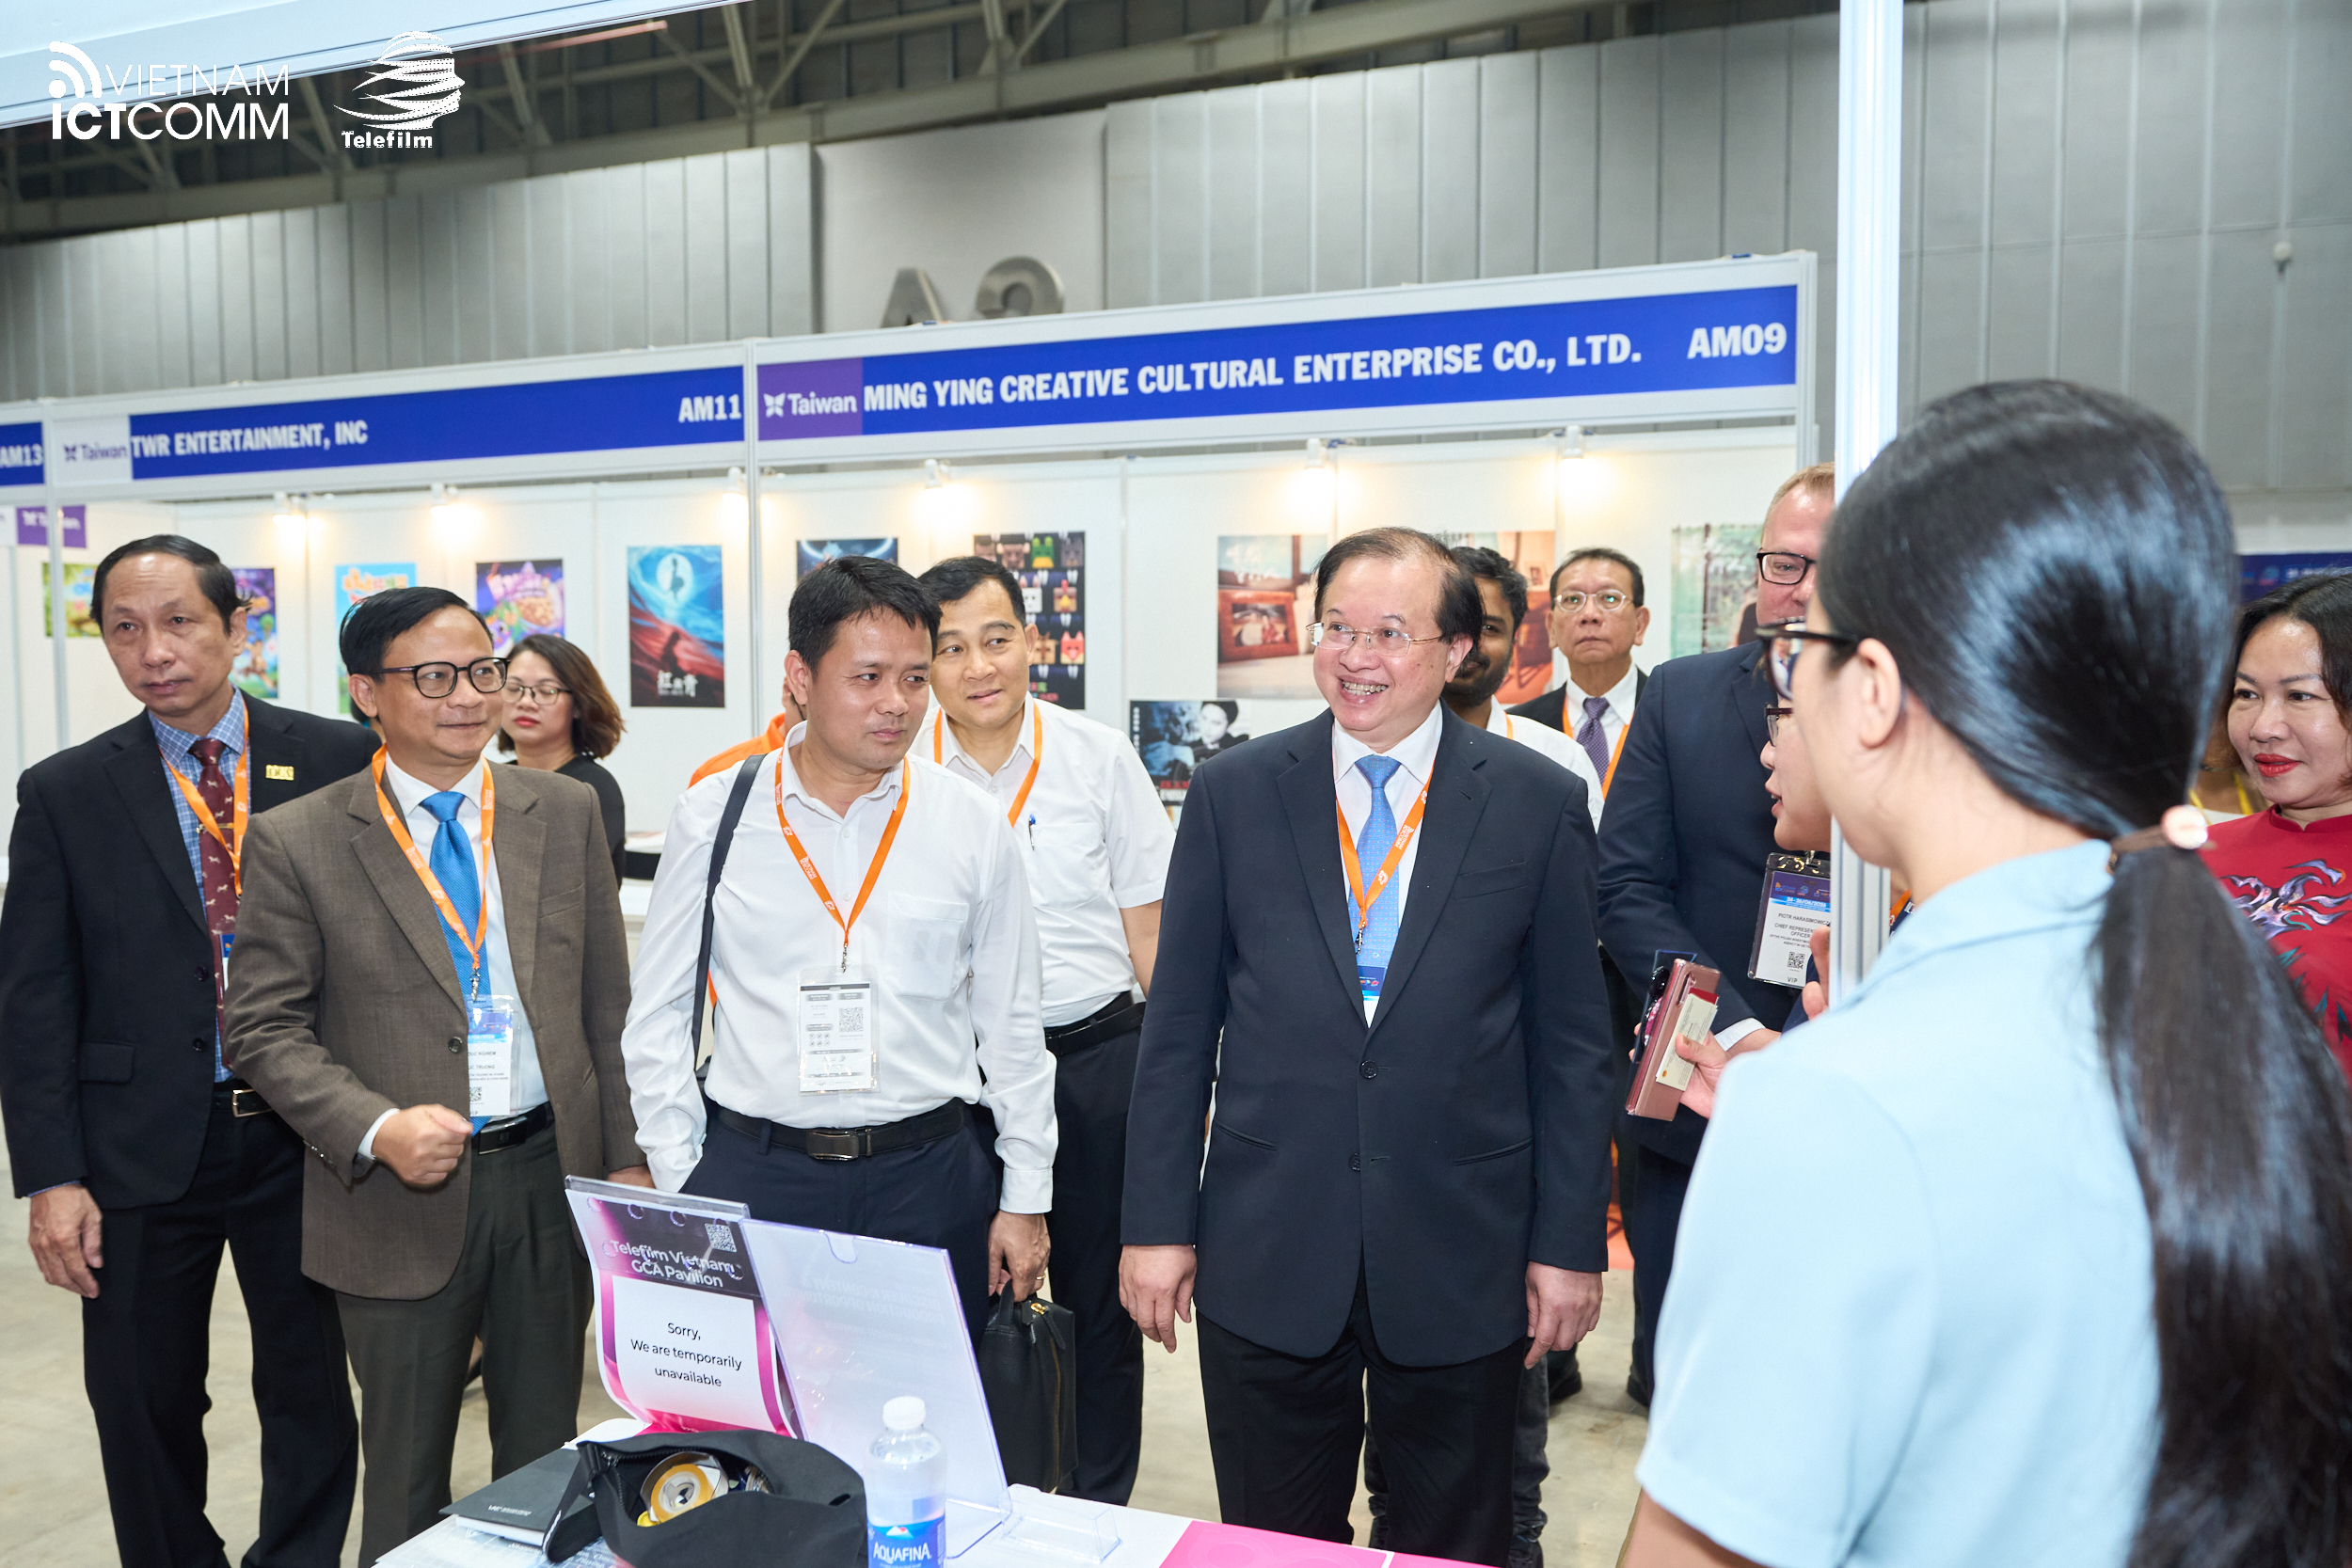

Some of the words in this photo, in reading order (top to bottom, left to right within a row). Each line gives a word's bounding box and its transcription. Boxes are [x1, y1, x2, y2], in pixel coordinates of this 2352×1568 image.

[1687, 322, 1788, 359] AM09
[864, 381, 928, 411] MING
[932, 376, 993, 406] YING
[999, 367, 1129, 403] CREATIVE
[1136, 356, 1284, 393] CULTURAL
[1294, 342, 1483, 384] ENTERPRISE
[1492, 339, 1556, 374] CO.,
[1566, 333, 1642, 366] LTD.
[677, 393, 741, 422] AM11
[787, 390, 857, 416] Taiwan
[81, 442, 128, 461] Taiwan
[132, 434, 170, 458] TWR
[174, 422, 331, 455] ENTERTAINMENT,
[335, 420, 369, 445] INC
[0, 443, 43, 468] AM13
[610, 1240, 670, 1262] Telefilm
[668, 1250, 735, 1274] Vietnam
[630, 1259, 664, 1277] GCA
[664, 1265, 723, 1288] Pavilion
[667, 1322, 701, 1340] Sorry,
[630, 1338, 649, 1352] We
[652, 1345, 670, 1355] are
[673, 1347, 742, 1370] temporarily
[654, 1368, 722, 1386] unavailable
[873, 1541, 931, 1564] AQUAFINA
